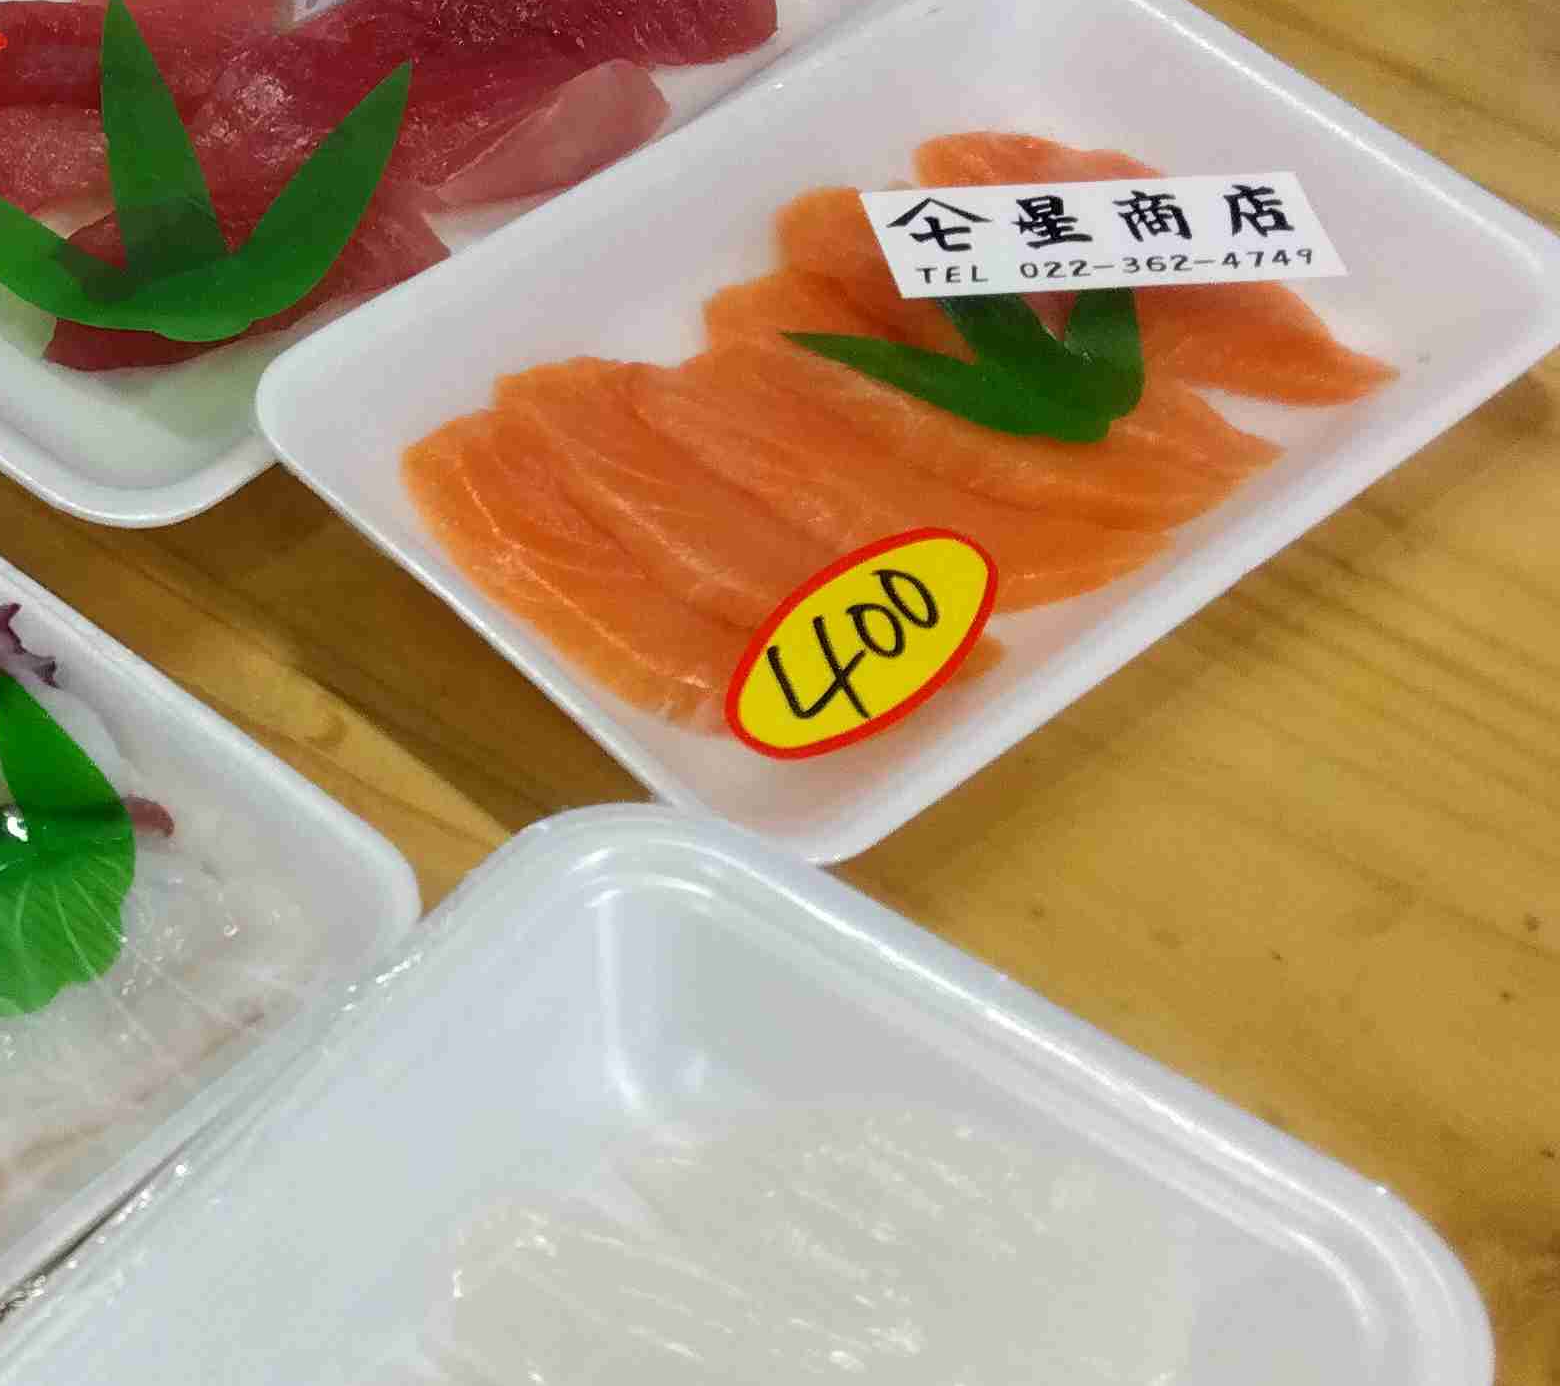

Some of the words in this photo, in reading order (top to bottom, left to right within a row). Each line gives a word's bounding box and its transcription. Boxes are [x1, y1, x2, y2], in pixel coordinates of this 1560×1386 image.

[915, 264, 989, 285] TEL
[1019, 247, 1314, 280] 022-362-4749
[766, 568, 939, 720] 400
